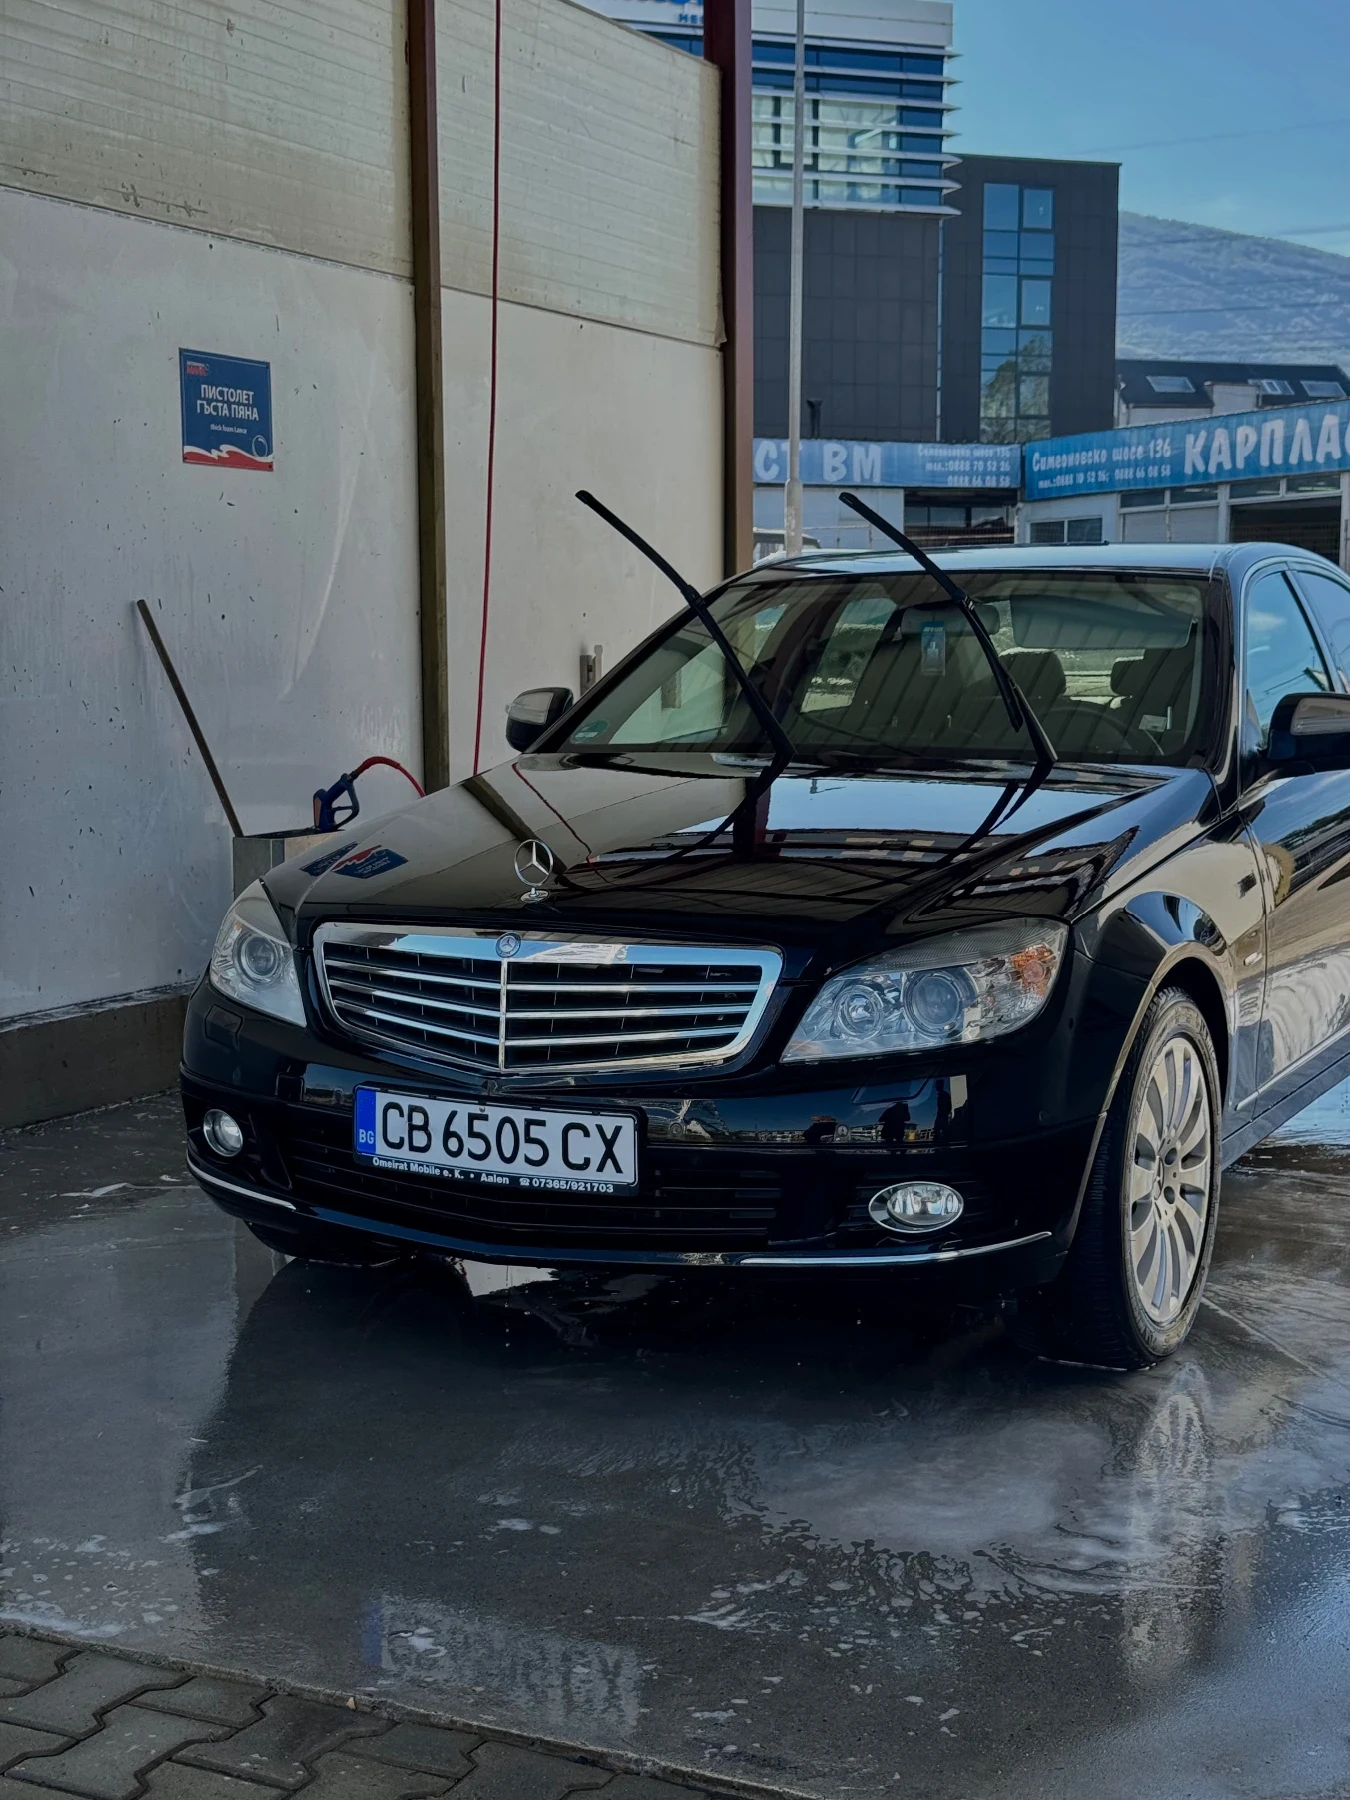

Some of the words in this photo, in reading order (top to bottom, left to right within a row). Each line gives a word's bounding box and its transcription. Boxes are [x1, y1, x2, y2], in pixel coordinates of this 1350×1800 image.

[196, 400, 230, 417] ГЪСТА
[231, 404, 260, 421] ПЯНА
[201, 384, 254, 405] ПИСТОЛЕТ
[1032, 448, 1107, 472] Симеоновско
[1112, 445, 1144, 462] шосе
[1148, 437, 1171, 459] 136
[1183, 414, 1350, 475] КАРПЛА
[822, 442, 882, 484] ВМ
[359, 1129, 375, 1145] BG
[382, 1101, 433, 1153] CB
[442, 1110, 549, 1167] 6505
[561, 1122, 623, 1174] CX
[372, 1156, 408, 1171] Omeirat
[410, 1162, 441, 1177] Mobile
[454, 1169, 464, 1179] K.
[480, 1172, 510, 1185] Aalen
[532, 1178, 614, 1194] 07365/921703
